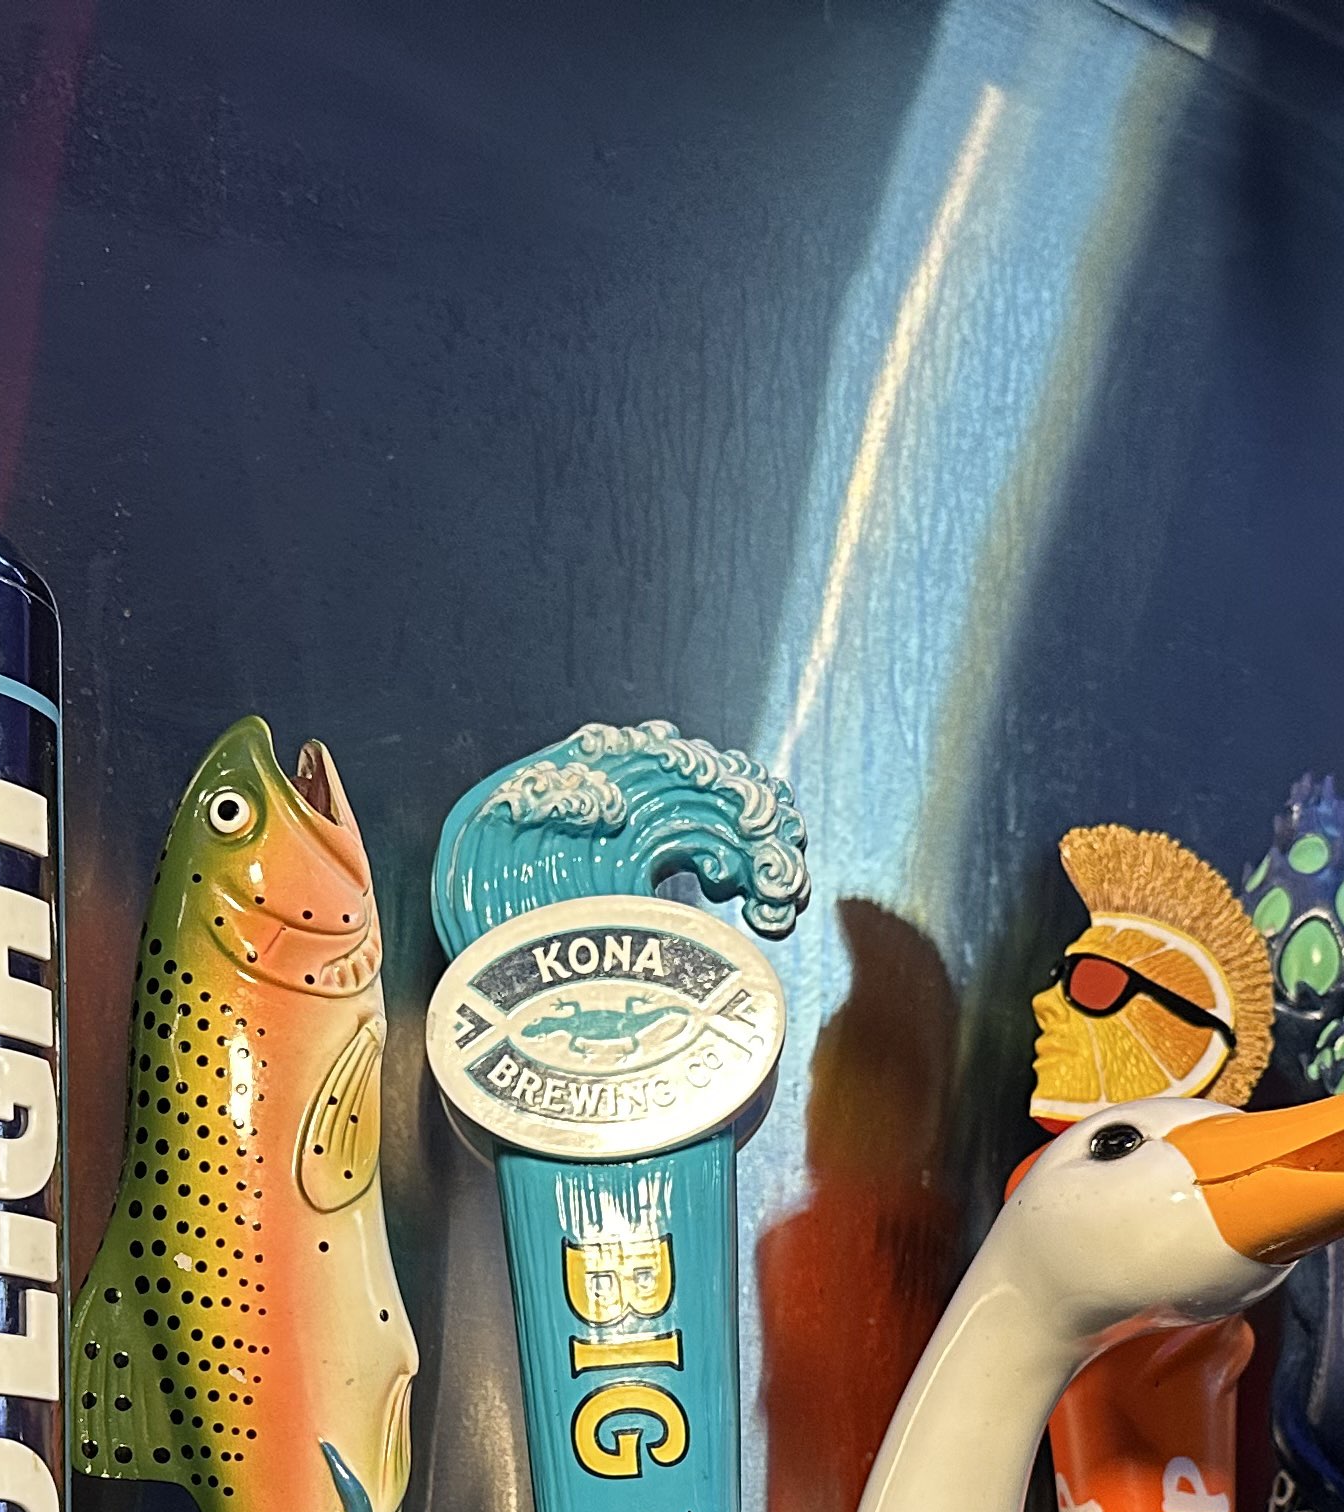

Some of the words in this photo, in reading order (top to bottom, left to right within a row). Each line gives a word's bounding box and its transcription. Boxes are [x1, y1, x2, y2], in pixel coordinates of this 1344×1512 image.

[531, 934, 664, 983] KONA
[487, 1054, 676, 1118] BREWING
[561, 1234, 691, 1480] BIG
